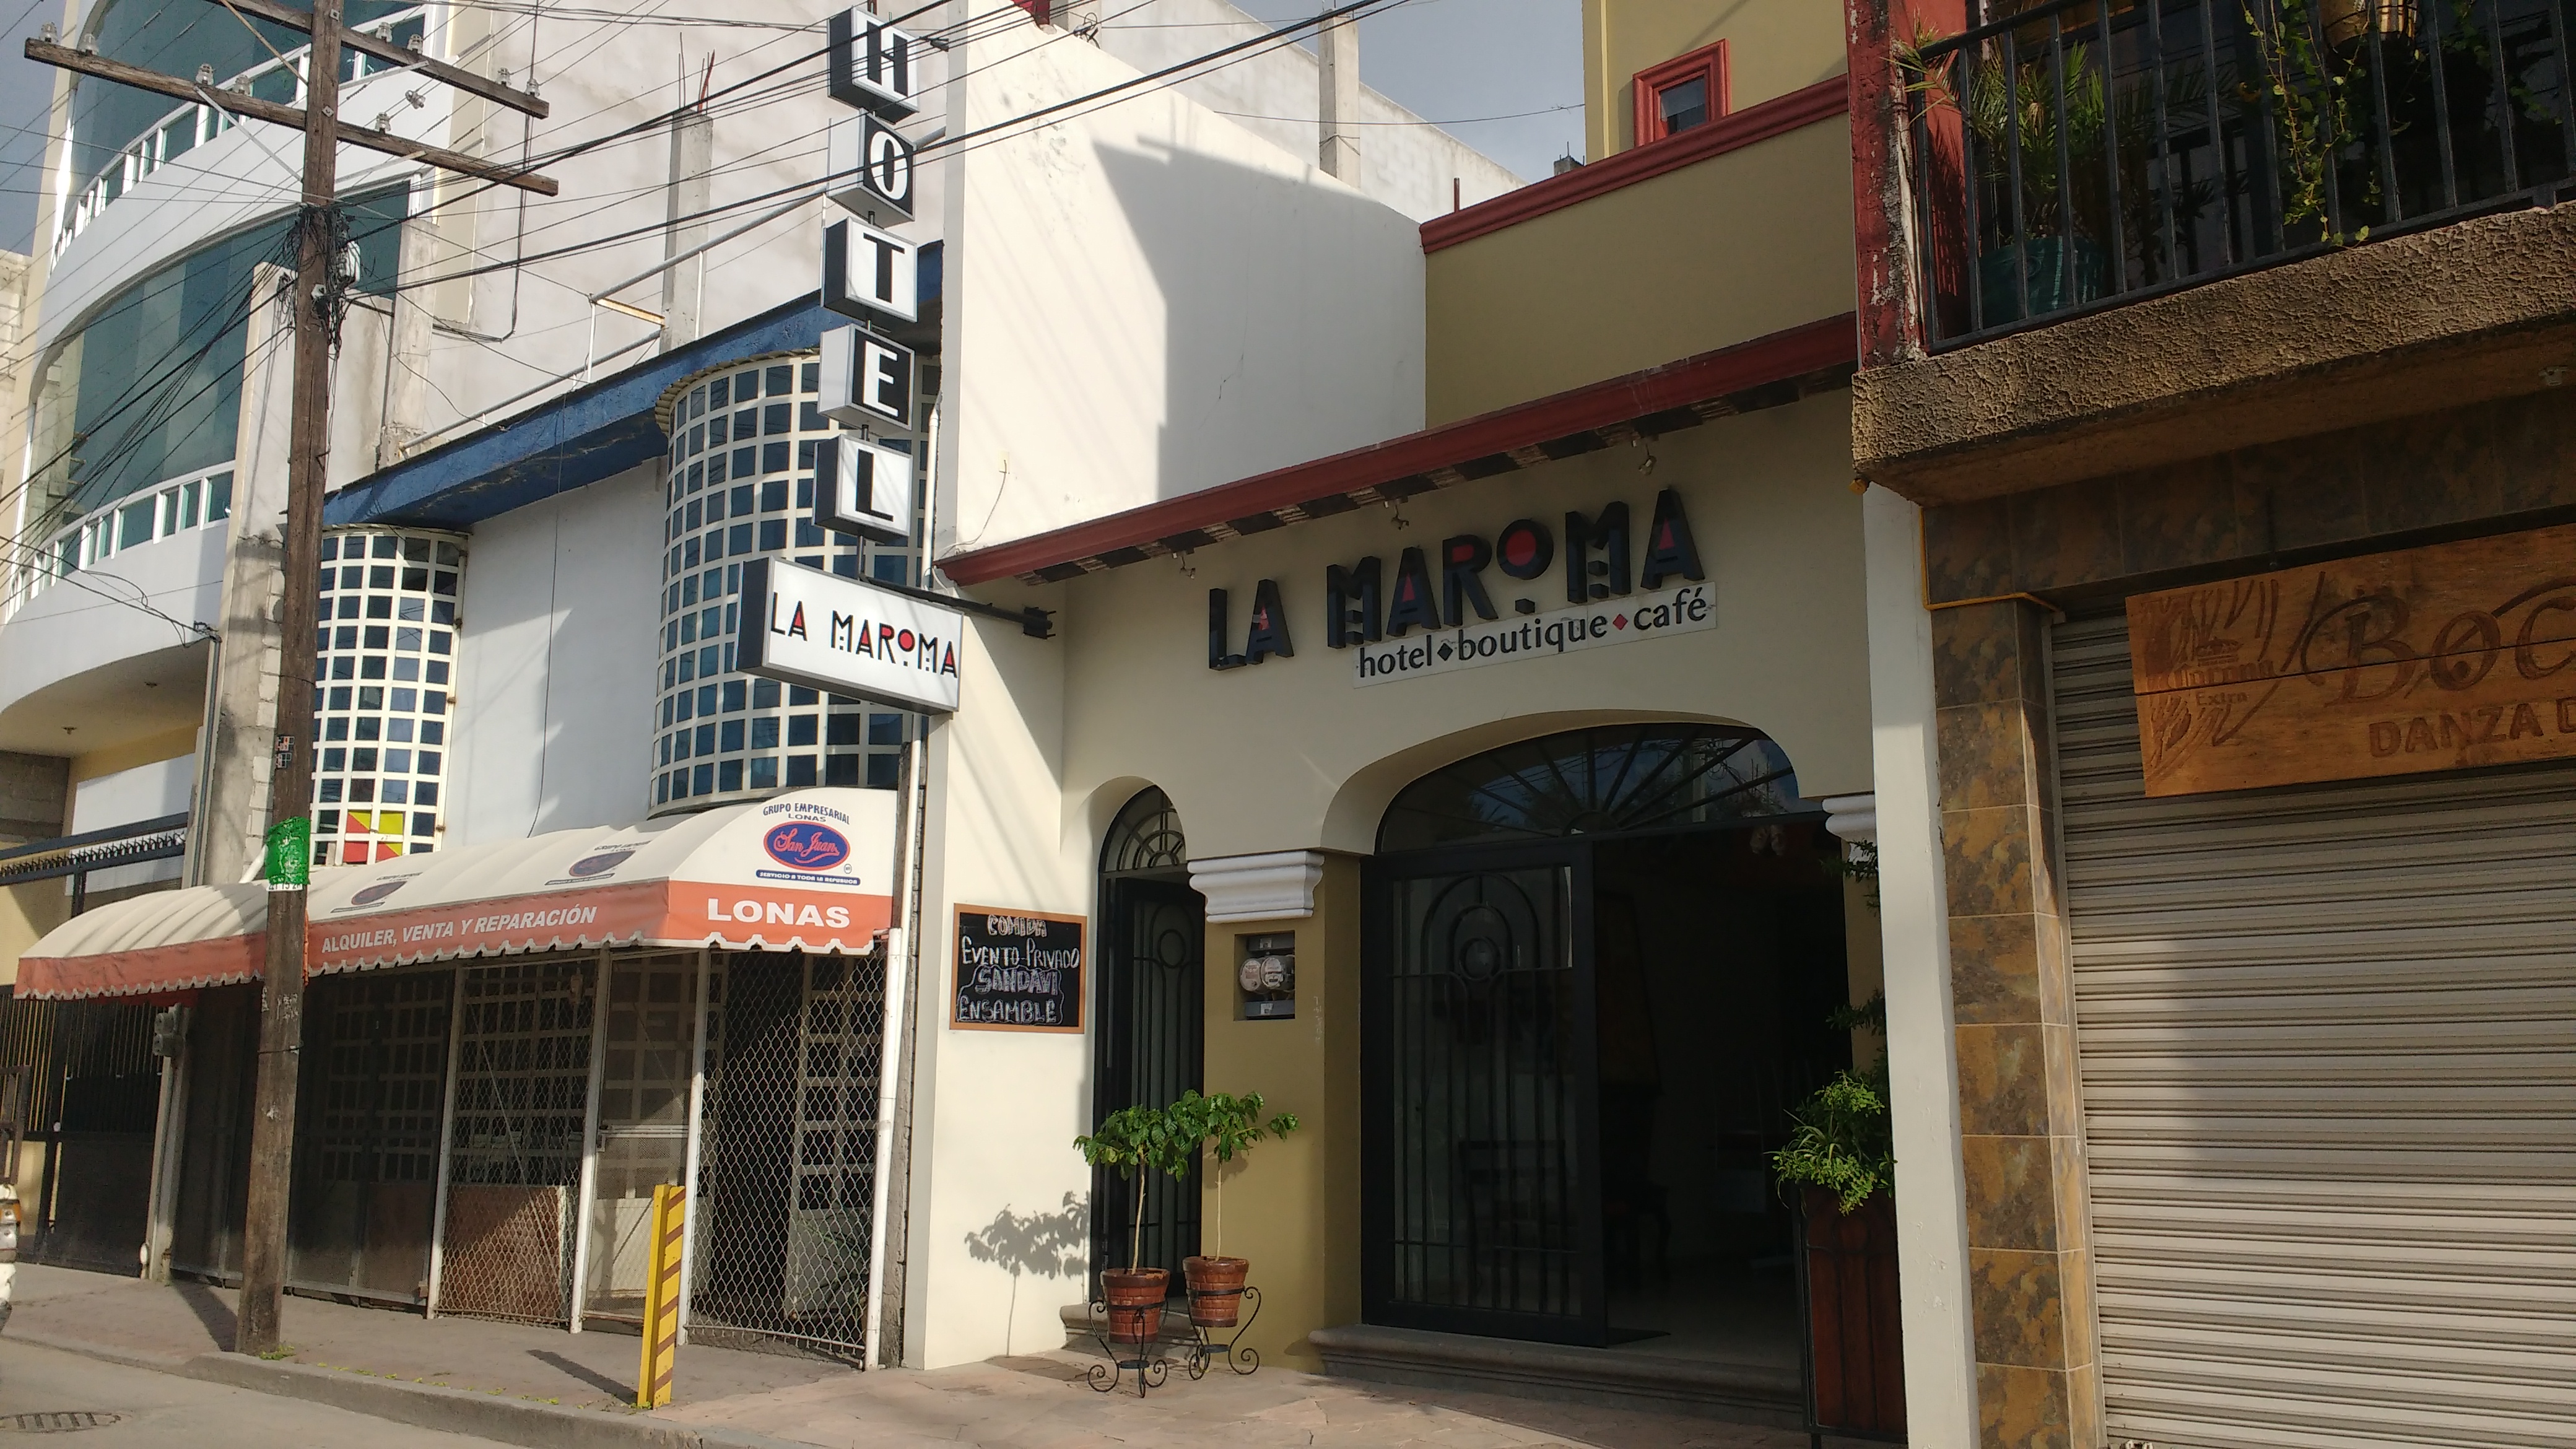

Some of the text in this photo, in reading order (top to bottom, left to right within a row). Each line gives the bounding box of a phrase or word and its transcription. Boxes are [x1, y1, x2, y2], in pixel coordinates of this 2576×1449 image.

[855, 20, 908, 523] HOTEL
[1208, 487, 1705, 671] LA MAROMA
[770, 592, 957, 679] LA MAROMA
[1359, 587, 1708, 679] hotel boutique café
[2369, 703, 2544, 758] DANZA
[763, 803, 850, 825] GRUPO EMPRESARIAL
[788, 813, 827, 822] LONAS
[774, 827, 840, 858] San Juan
[321, 903, 598, 954] ALQUILER, VENTA Y REPARACIÓN
[708, 898, 851, 929] LONAS
[987, 914, 1047, 938] COMIDA
